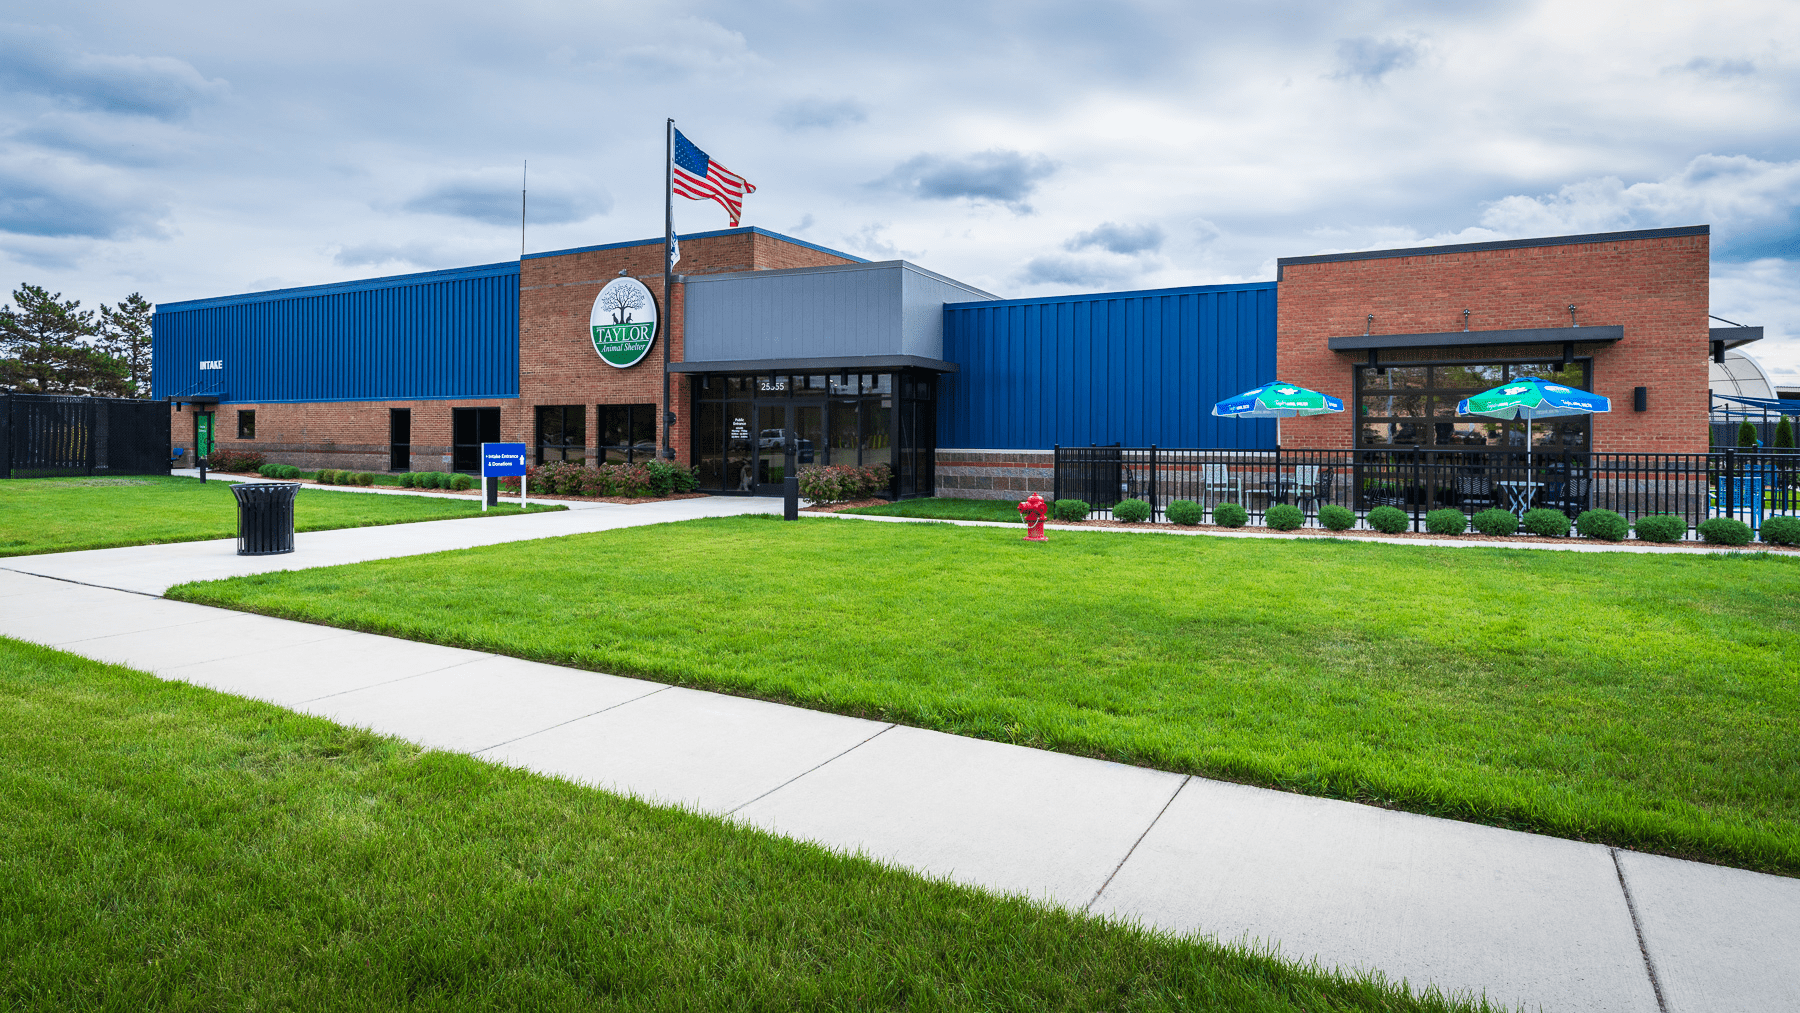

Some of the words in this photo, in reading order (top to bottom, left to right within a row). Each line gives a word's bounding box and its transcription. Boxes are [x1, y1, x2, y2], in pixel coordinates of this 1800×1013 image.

[597, 326, 650, 343] TAYLOR
[601, 343, 623, 353] Animal
[624, 342, 646, 352] Shelter
[199, 360, 223, 370] INTAKE
